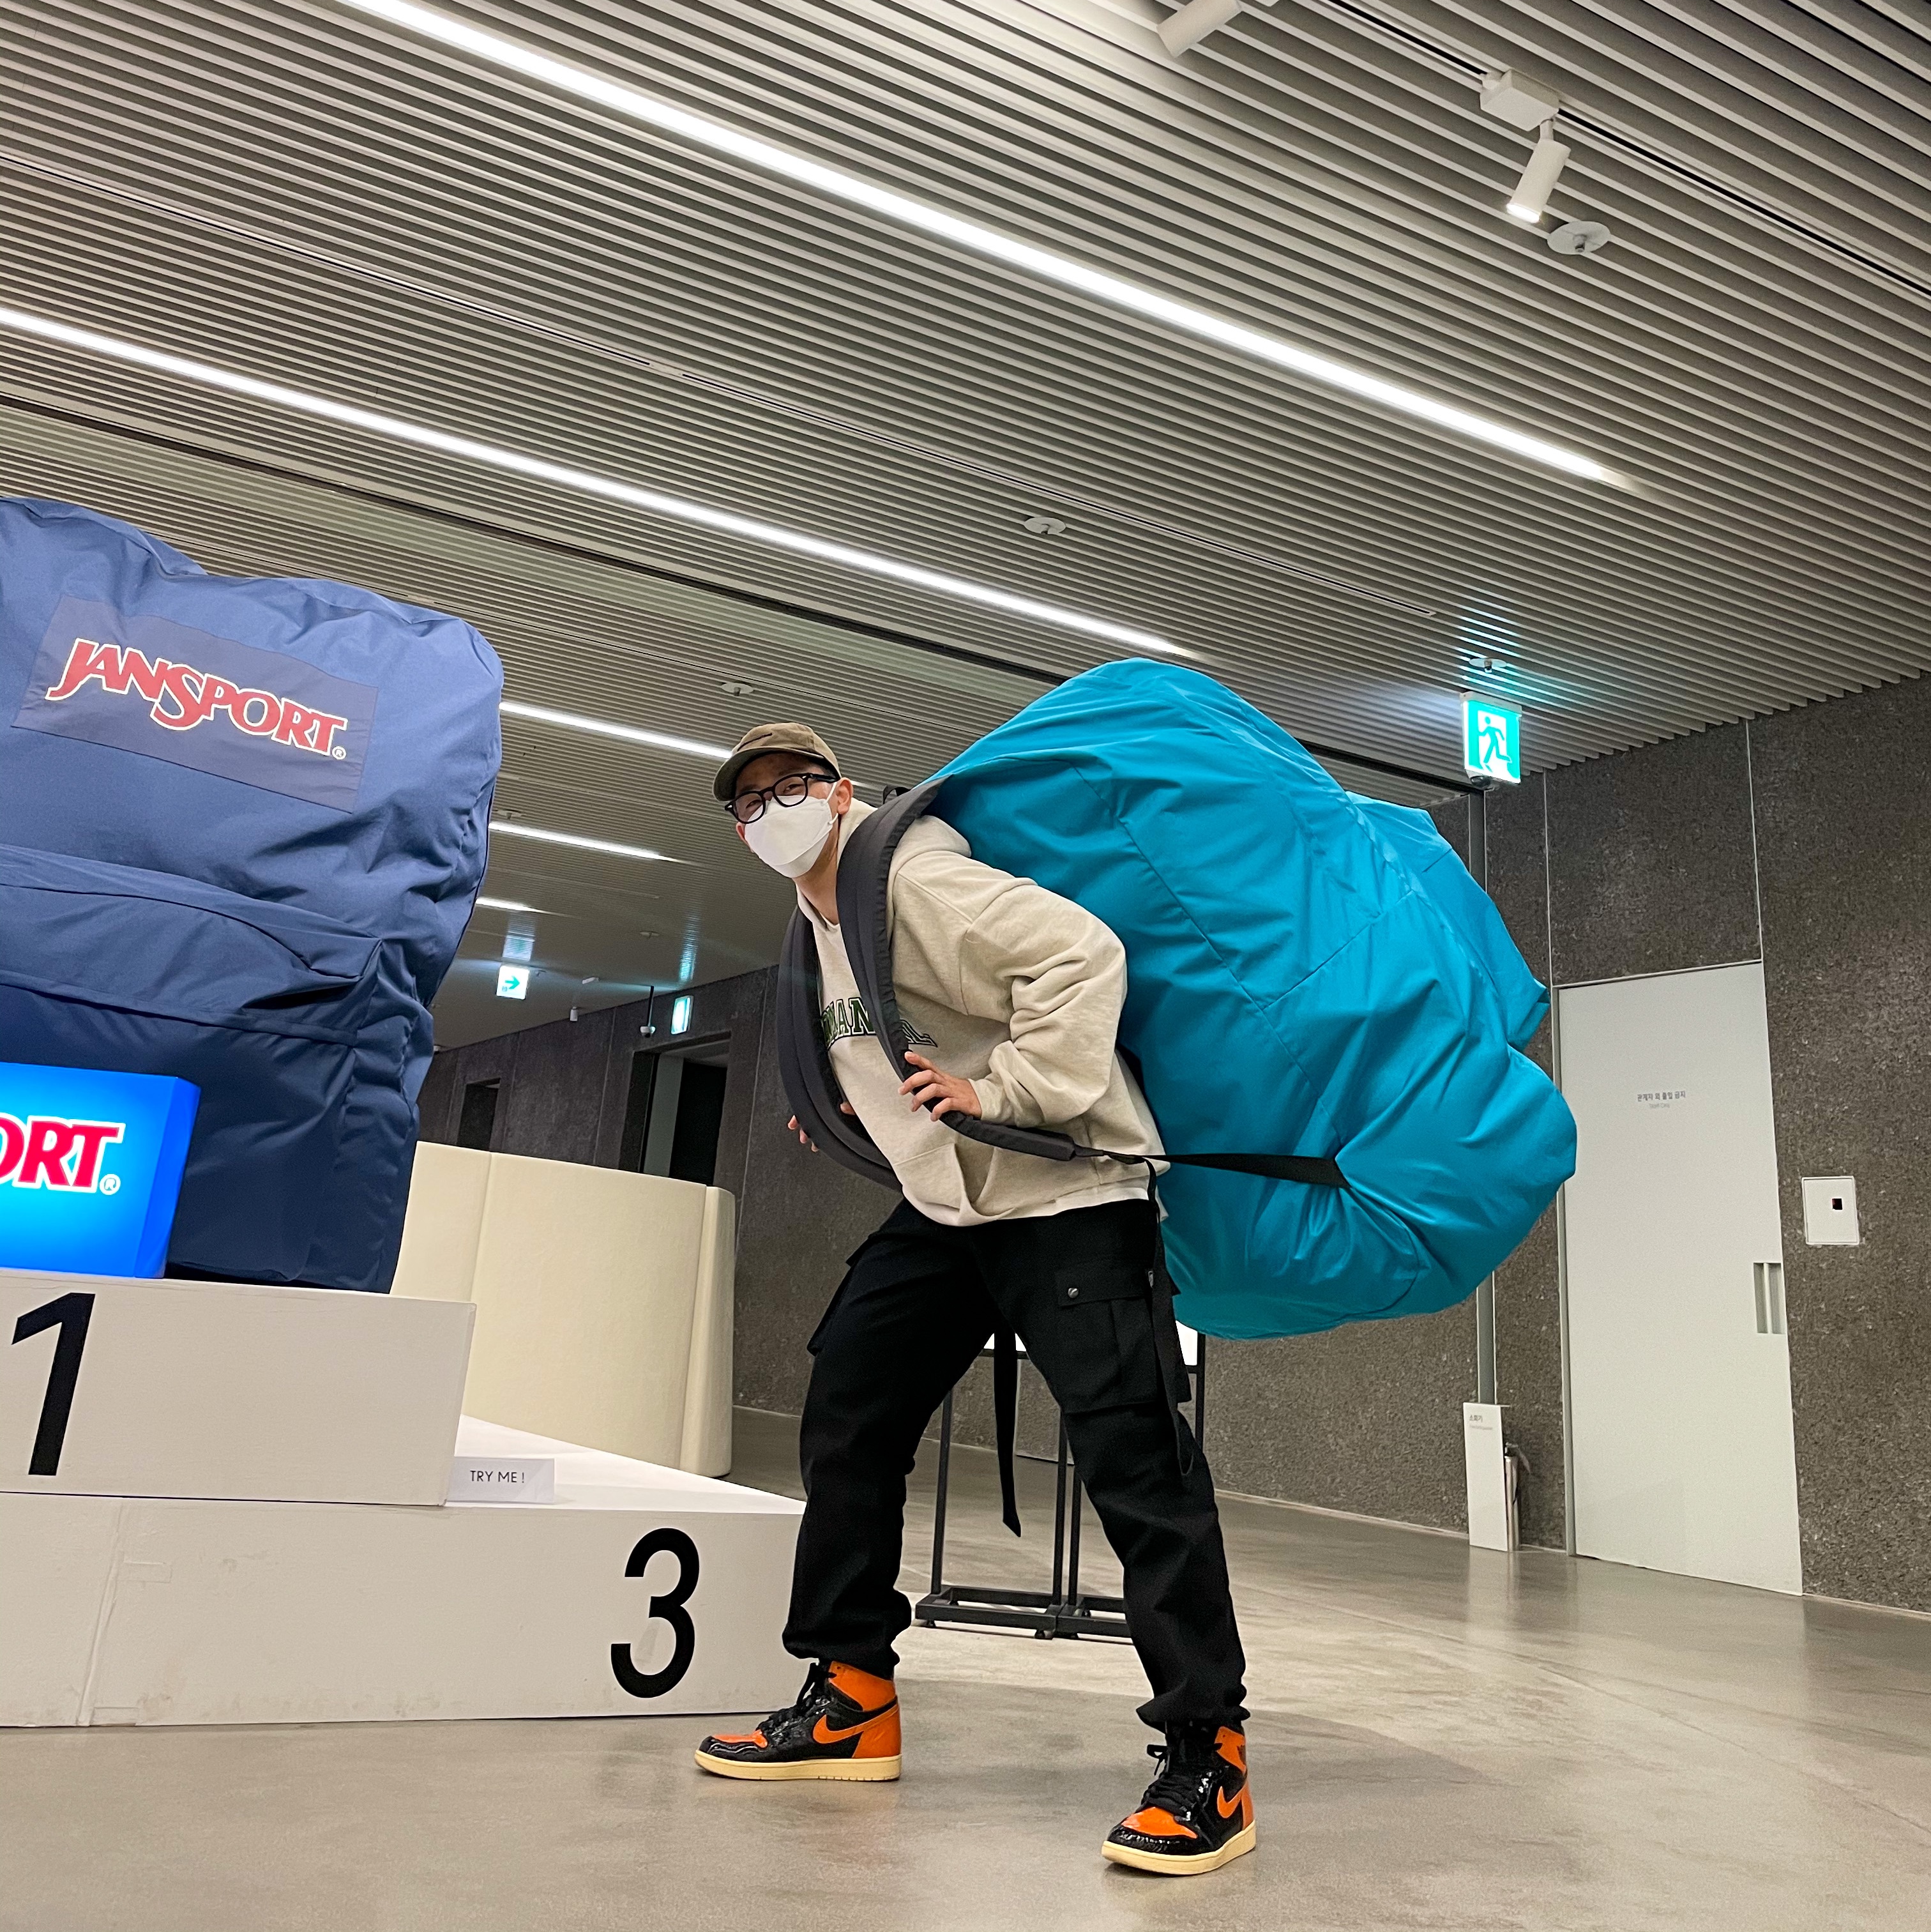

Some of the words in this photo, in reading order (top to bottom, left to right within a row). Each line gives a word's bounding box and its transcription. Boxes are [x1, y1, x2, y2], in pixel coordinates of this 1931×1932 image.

[11, 1292, 96, 1476] 1
[470, 1470, 494, 1482] TRY
[610, 1528, 700, 1699] 3
